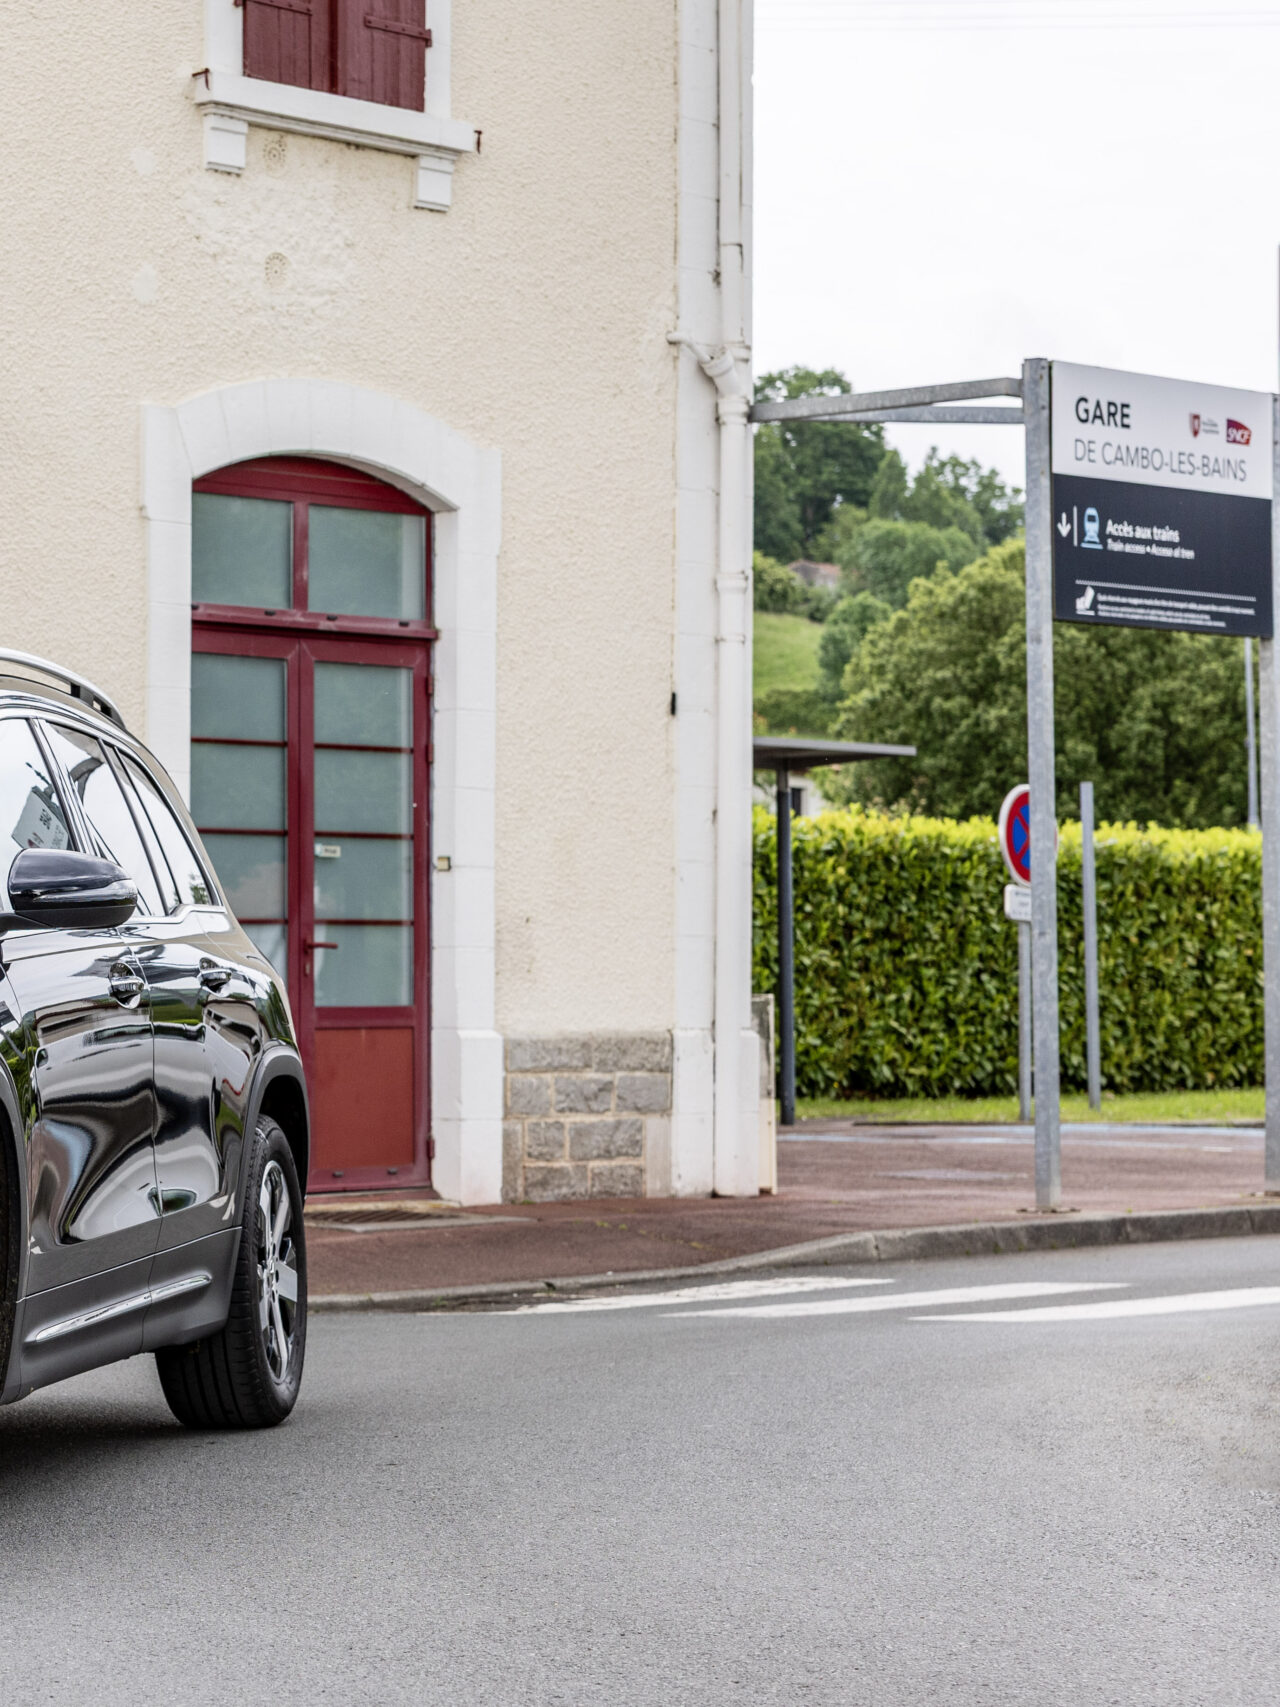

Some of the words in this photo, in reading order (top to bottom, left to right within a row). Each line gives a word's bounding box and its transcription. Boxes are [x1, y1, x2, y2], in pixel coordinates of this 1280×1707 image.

[1075, 396, 1131, 429] GARE
[1227, 426, 1251, 444] SNCF
[1074, 438, 1097, 464] DE
[1102, 441, 1247, 482] CAMBO-LES-BAINS
[1106, 518, 1134, 538] Accès
[1135, 526, 1152, 540] aux
[1153, 525, 1180, 543] trains
